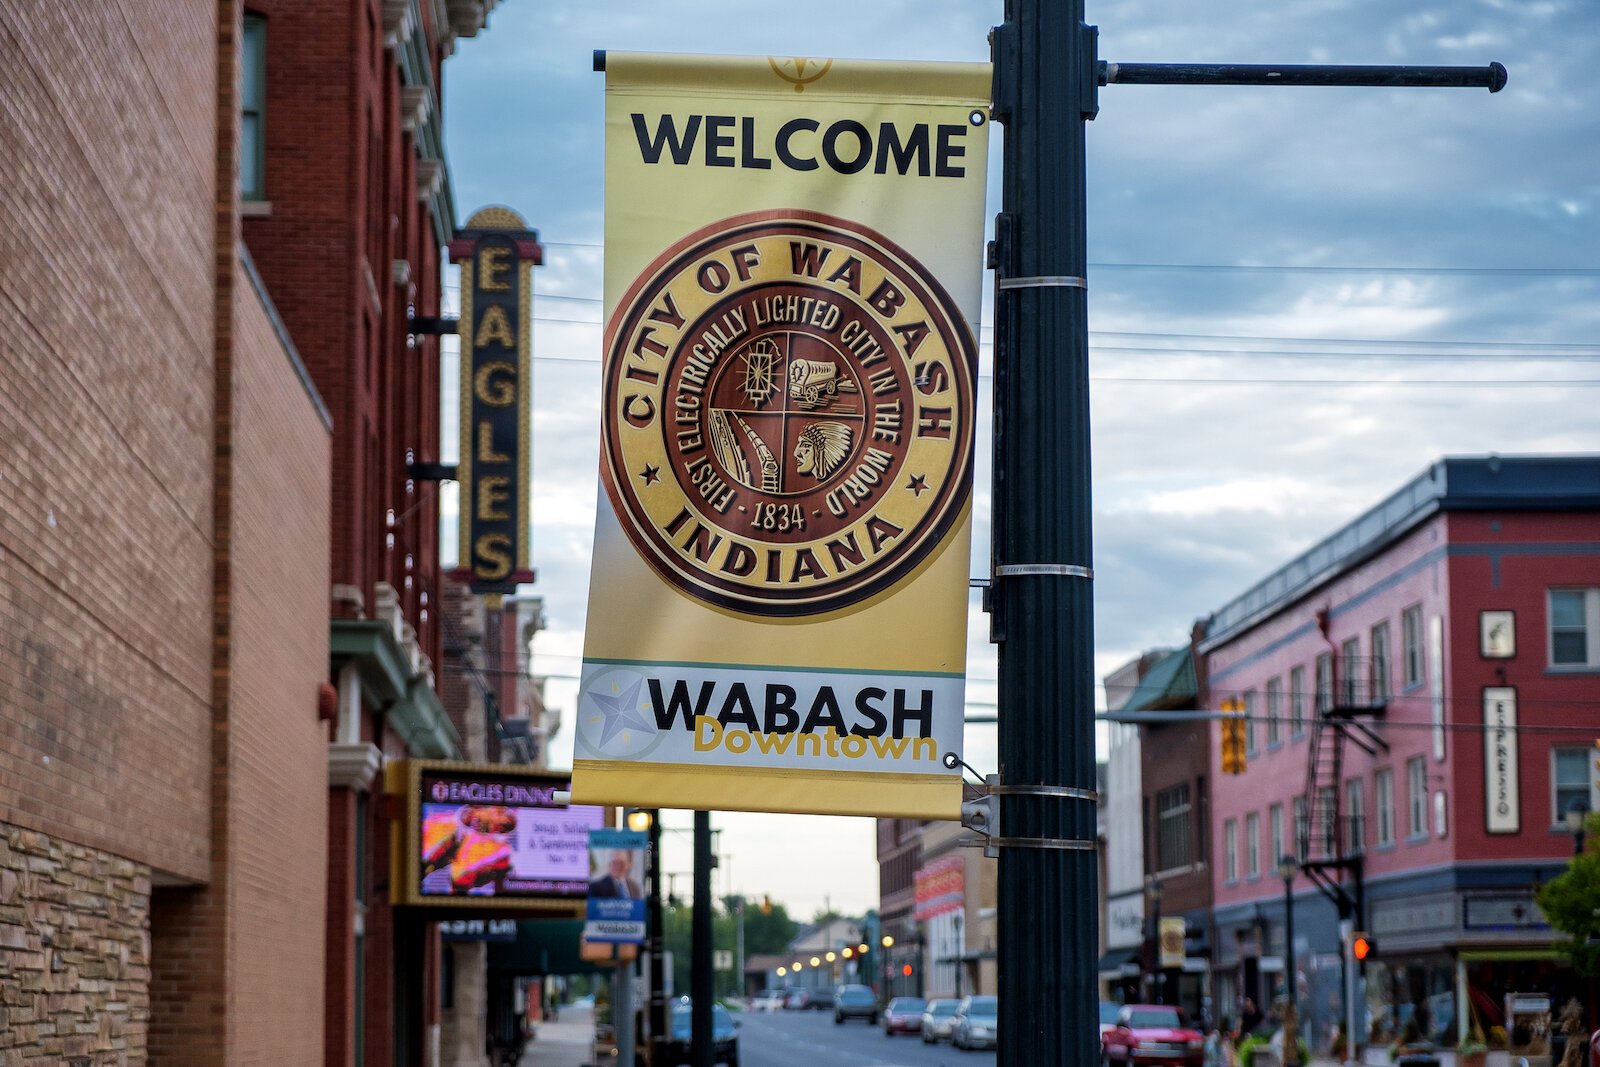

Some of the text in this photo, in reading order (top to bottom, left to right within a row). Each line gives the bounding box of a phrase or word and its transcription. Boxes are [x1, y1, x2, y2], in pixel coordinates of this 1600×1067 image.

[630, 113, 968, 177] WELCOME
[623, 241, 953, 440] CITY OF WABASH
[474, 247, 518, 581] EAGLES
[675, 295, 900, 516] FIRST ELECTRICALLY LIGHTED CITY IN THE WORLD
[662, 505, 904, 583] INDIANA
[751, 501, 804, 530] 1834
[647, 678, 934, 740] WABASH
[693, 714, 938, 761] Downtown
[449, 782, 504, 802] EAGLES
